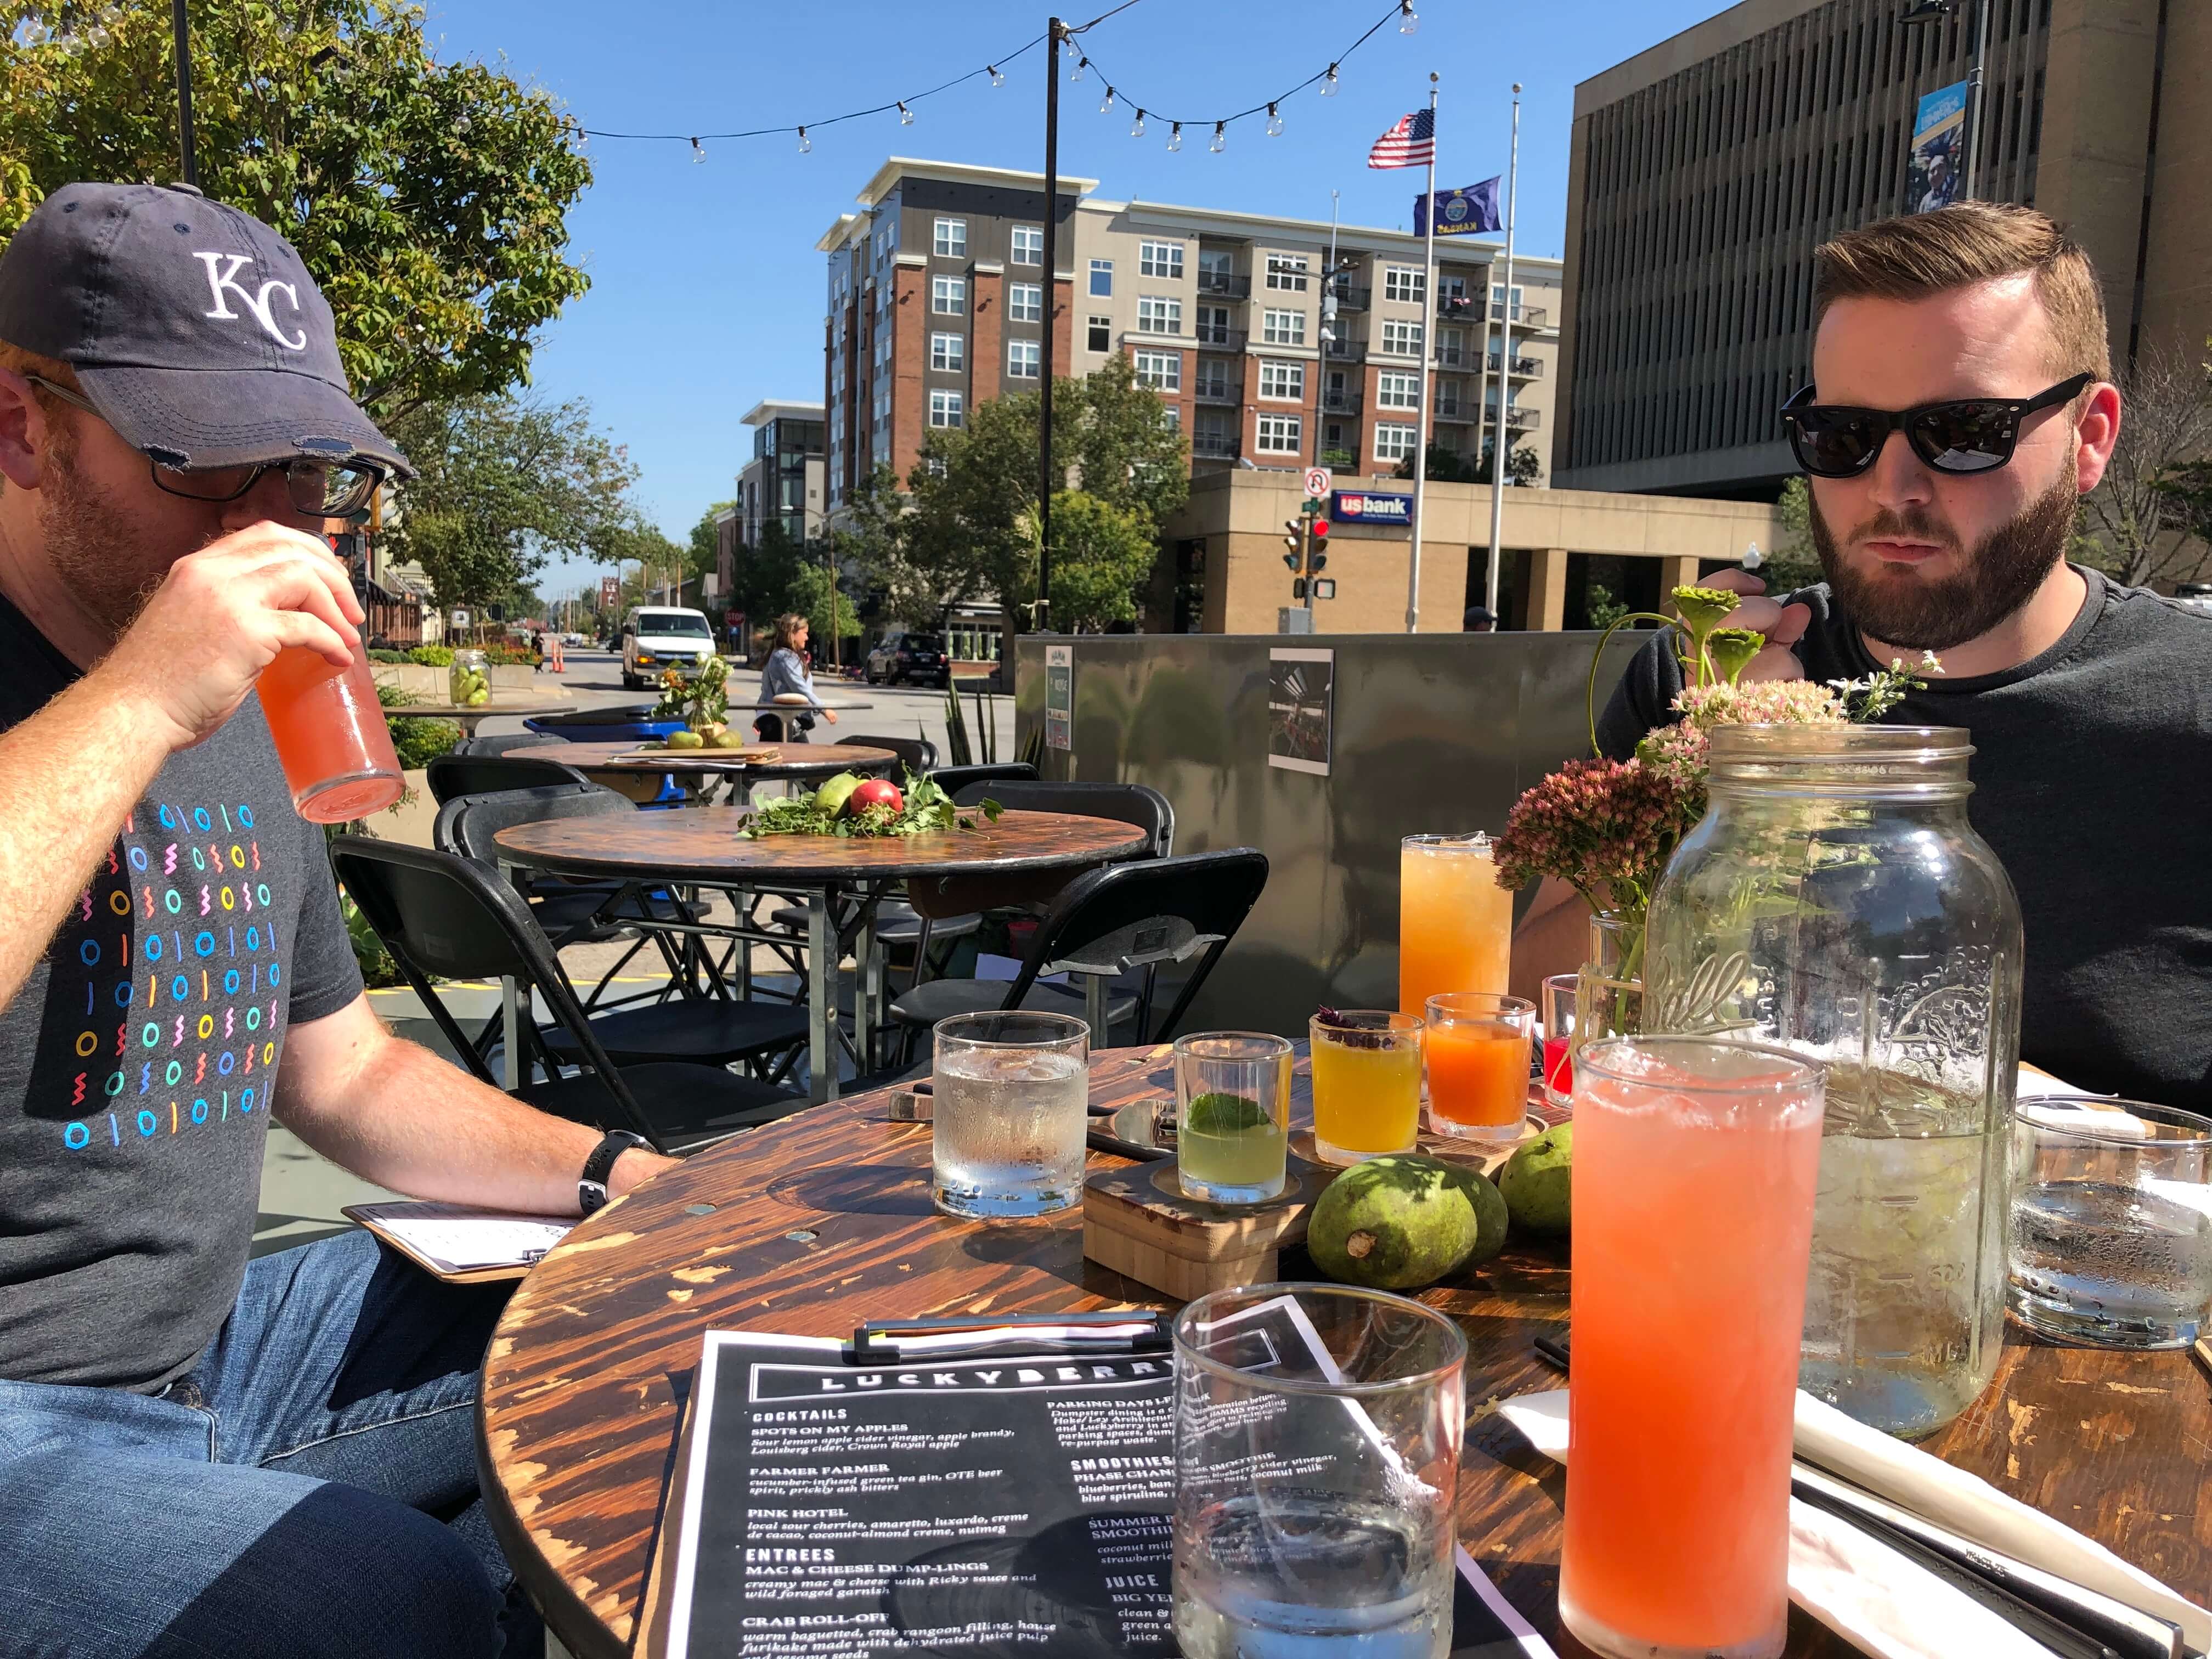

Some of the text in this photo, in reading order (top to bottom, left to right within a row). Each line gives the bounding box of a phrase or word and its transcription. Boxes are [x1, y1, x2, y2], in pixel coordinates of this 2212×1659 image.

[193, 252, 307, 351] KC
[727, 612, 744, 620] STOP
[1115, 1399, 1153, 1408] DAYS
[753, 1408, 848, 1423] COCKTAILS
[1051, 1409, 1105, 1418] Dumpster
[1108, 1408, 1143, 1417] dining
[751, 1424, 909, 1436] SPOTS ON MY APPLES
[1056, 1424, 1076, 1432] and
[1080, 1421, 1144, 1431] Luckyberry
[782, 1437, 819, 1446] lemon
[821, 1435, 853, 1446] apple
[855, 1435, 885, 1443] cider
[888, 1434, 934, 1443] vinegar,
[938, 1432, 968, 1442] apple
[971, 1429, 1015, 1438] brandy,
[1058, 1431, 1103, 1441] parking
[1107, 1429, 1143, 1438] spaces,
[812, 1444, 844, 1454] cider,
[848, 1443, 888, 1451] Crown
[891, 1440, 926, 1451] Royal
[928, 1440, 960, 1450] apple
[1061, 1439, 1119, 1448] re-purpose
[749, 1463, 890, 1476] FARMER FARMER
[1070, 1455, 1173, 1471] SMOOTHIES
[749, 1469, 1003, 1487] cucumber-infused green tea gin, OTE beer
[1073, 1471, 1124, 1482] PHASE
[749, 1483, 900, 1496] spirit, prickly ash bitters
[1079, 1482, 1147, 1494] blueberries,
[1081, 1493, 1107, 1504] blue
[747, 1508, 849, 1519] PINK HOTEL
[747, 1513, 1029, 1530] local sour cherries, amaretto, luxardo, creme
[1088, 1516, 1162, 1529] SUMMER
[747, 1525, 1007, 1541] de cacao, coconut-almond creme, nutmeg
[1098, 1543, 1144, 1553] coconut
[746, 1548, 835, 1562] ENTREES
[1101, 1553, 1173, 1564] strawberrie
[746, 1562, 989, 1575] MAC & CHEESE DUMP-LINGS
[744, 1581, 797, 1591] creamy
[833, 1578, 846, 1587] &
[849, 1577, 890, 1587] cheese
[895, 1577, 924, 1585] with
[929, 1575, 969, 1585] Ricky
[973, 1575, 1008, 1583] sauce
[1012, 1574, 1037, 1582] and
[1105, 1574, 1159, 1588] JUICE
[745, 1586, 890, 1600] wild foraged garnish
[1111, 1593, 1142, 1602] BIG
[1118, 1608, 1152, 1617] clean
[1157, 1609, 1169, 1617] &
[742, 1612, 890, 1628] CRAB ROLL-OFF
[1122, 1621, 1160, 1631] green
[743, 1633, 787, 1643] warm
[868, 1627, 899, 1637] crab
[904, 1626, 961, 1637] rangoon
[963, 1622, 1013, 1634] filling,
[1018, 1620, 1056, 1631] house
[1126, 1632, 1162, 1642] juice.
[738, 1631, 1048, 1657] furikake made with dehydrated juice pulp
[832, 1650, 870, 1659] seeds
